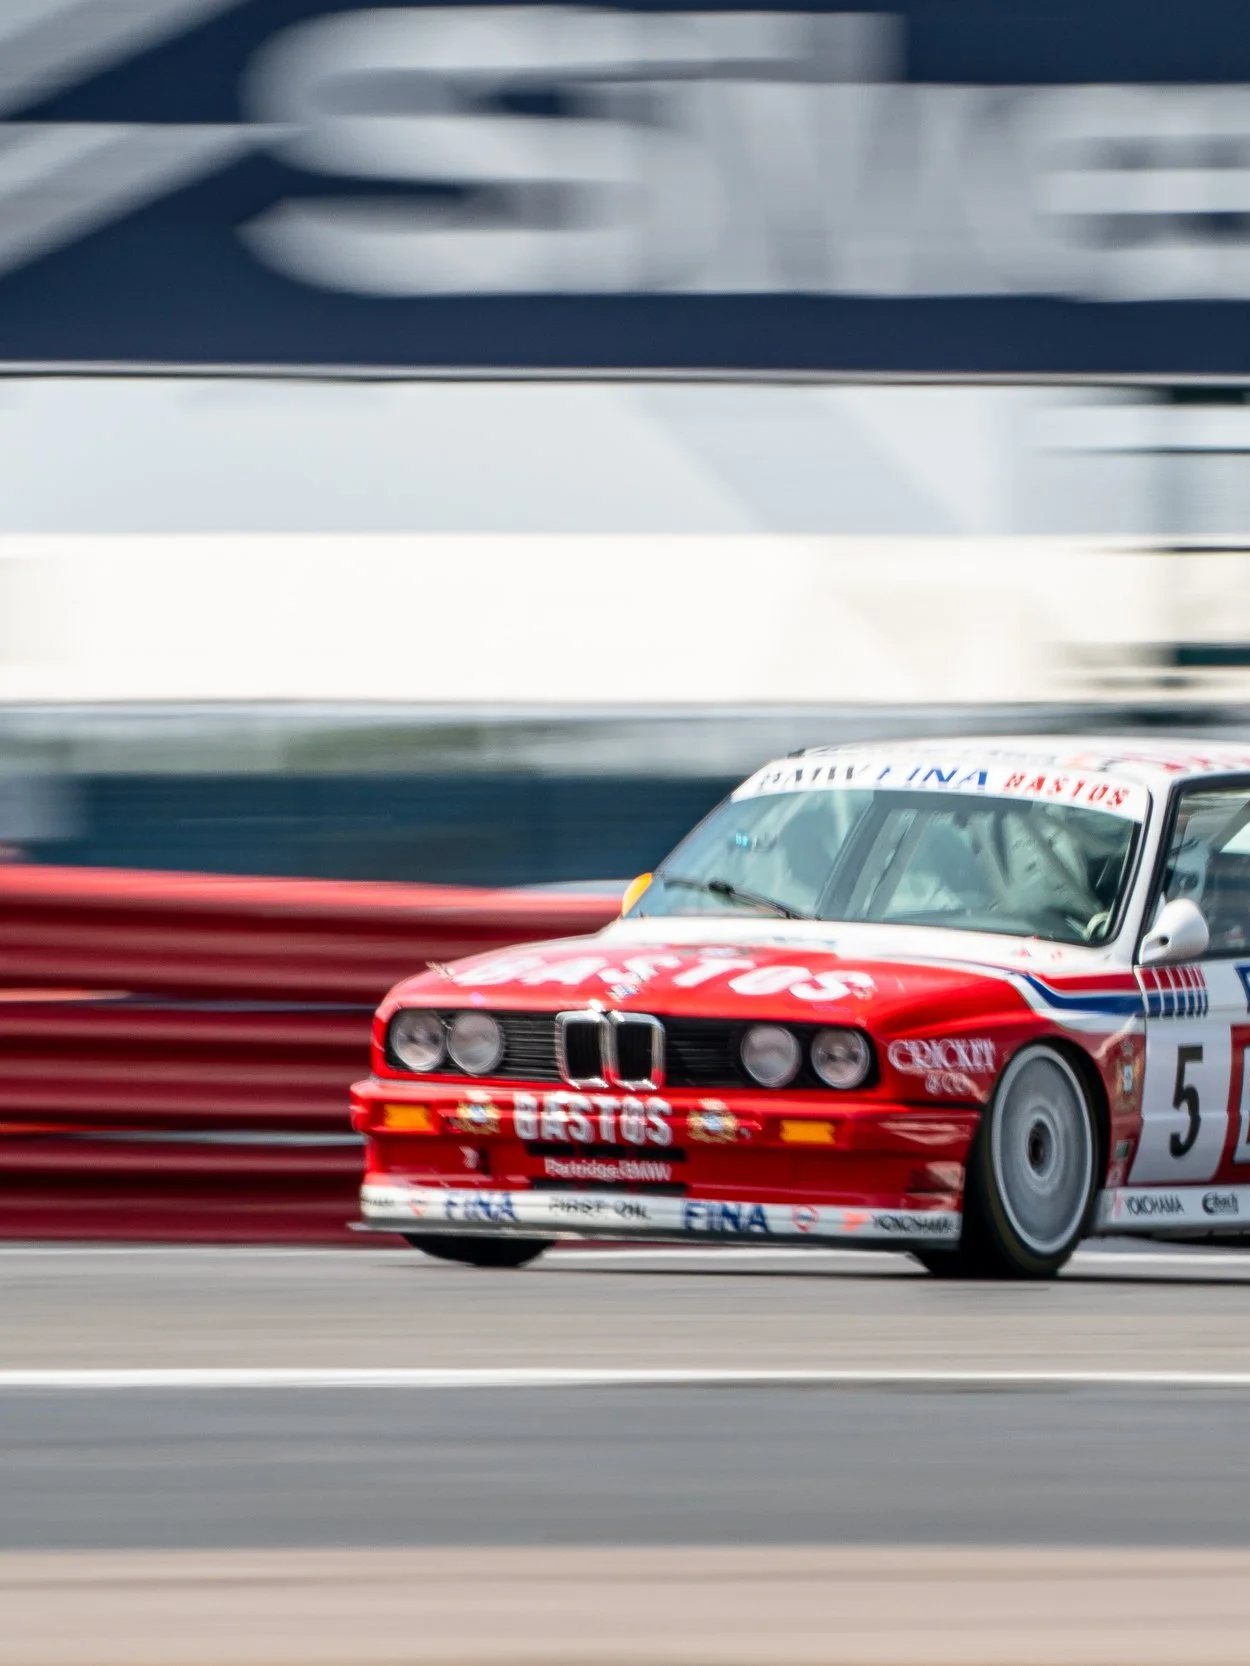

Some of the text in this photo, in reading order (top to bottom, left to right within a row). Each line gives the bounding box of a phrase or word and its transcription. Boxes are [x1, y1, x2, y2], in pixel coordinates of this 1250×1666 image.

[876, 766, 989, 789] FINA
[1003, 771, 1130, 808] BASTOS
[452, 955, 876, 1001] BASTOS
[513, 1090, 674, 1146] BASTOS
[1169, 1045, 1203, 1161] 5
[444, 1190, 519, 1224] FINA
[682, 1202, 773, 1233] FINA
[1126, 1196, 1186, 1217] YOKOHAMA
